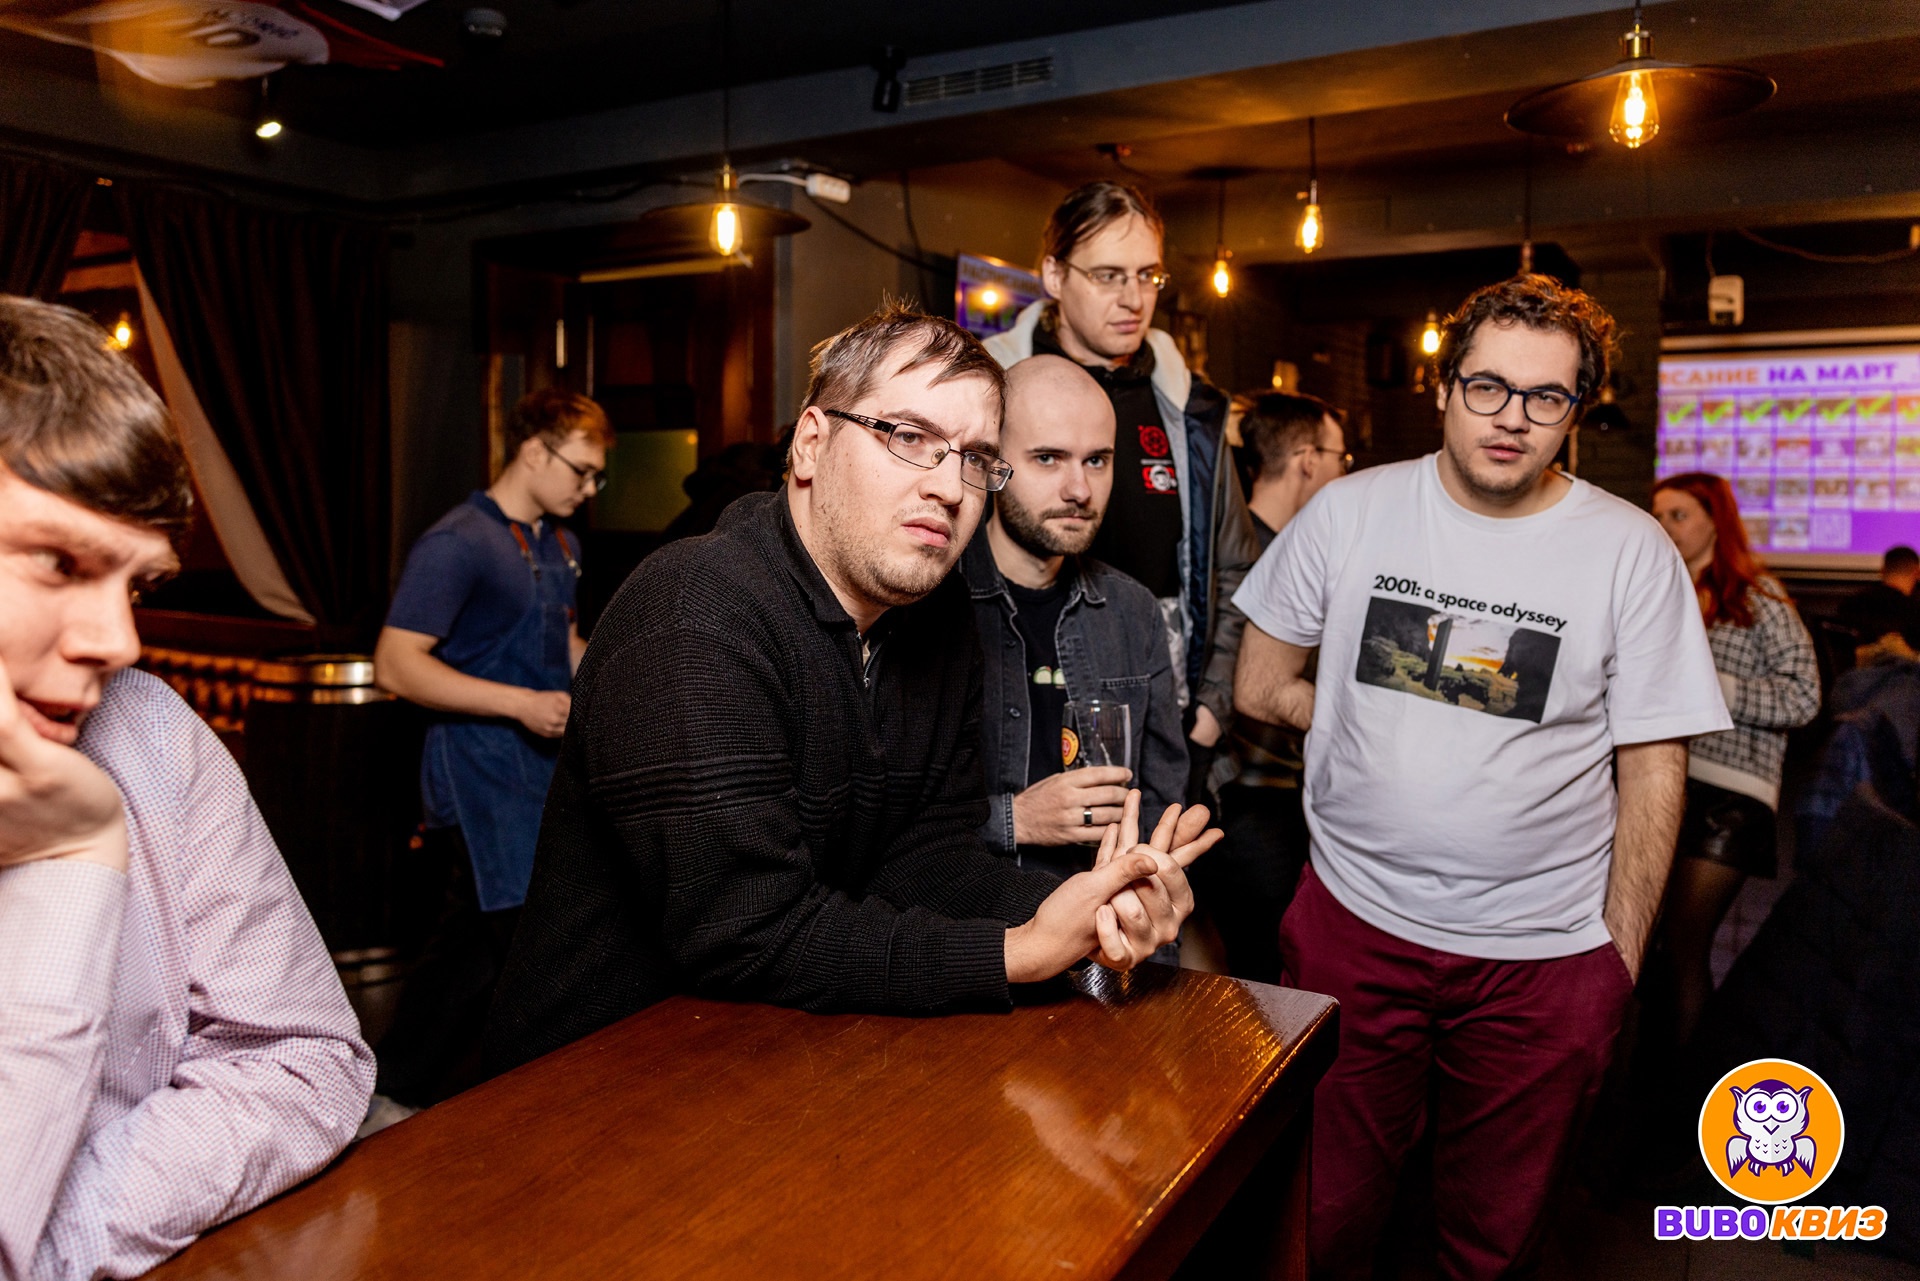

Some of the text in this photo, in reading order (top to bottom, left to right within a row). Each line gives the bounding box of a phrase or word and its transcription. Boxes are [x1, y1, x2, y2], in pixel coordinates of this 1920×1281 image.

[1768, 366, 1807, 382] НА
[1817, 362, 1897, 381] МАРТ
[1373, 574, 1568, 632] 2001: a space odyssey
